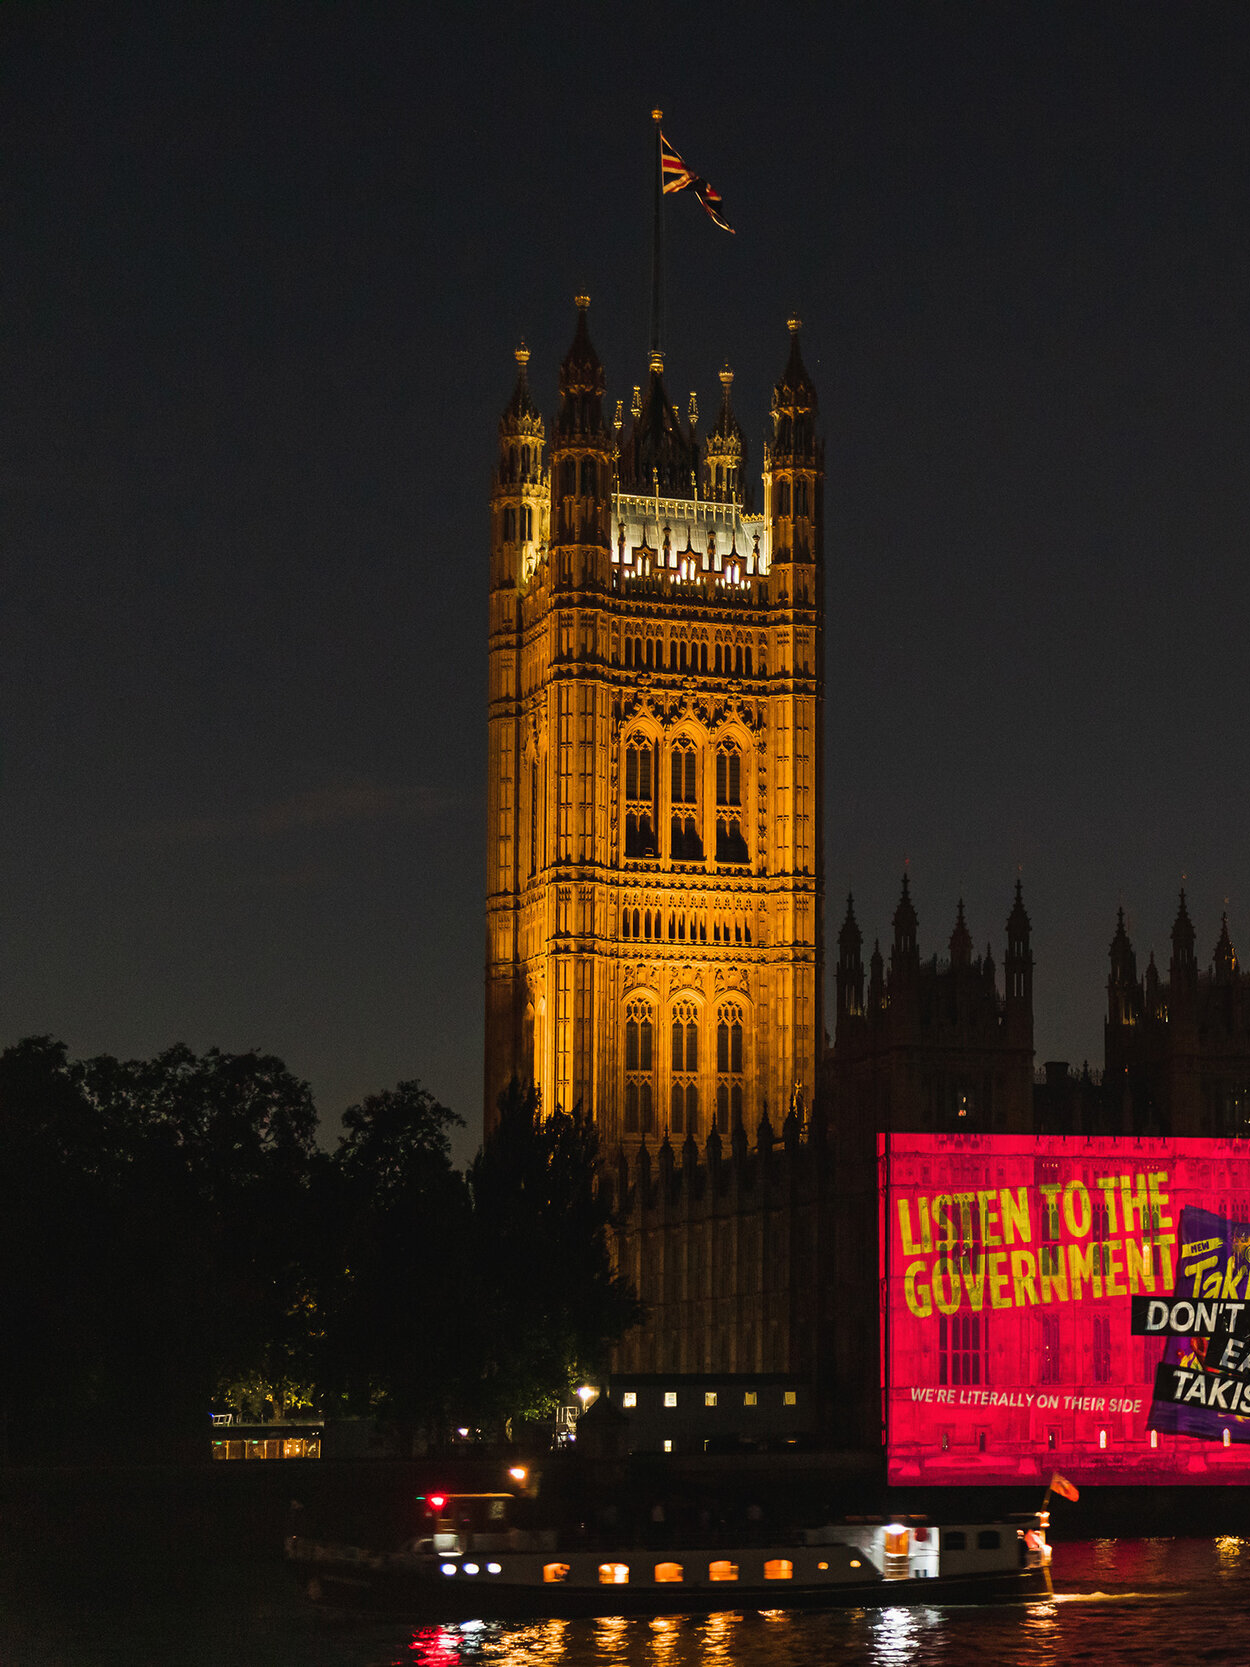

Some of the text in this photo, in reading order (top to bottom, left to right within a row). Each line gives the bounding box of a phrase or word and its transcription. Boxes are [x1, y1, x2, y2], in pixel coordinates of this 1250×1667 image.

[897, 1171, 1173, 1257] LISTEN TO THE
[1190, 1241, 1210, 1254] NEW
[903, 1233, 1177, 1318] GOVERNMENT
[1146, 1300, 1245, 1333] DON'T
[910, 1387, 1143, 1413] WE'RE LITERALLY ON THEIR SIDE
